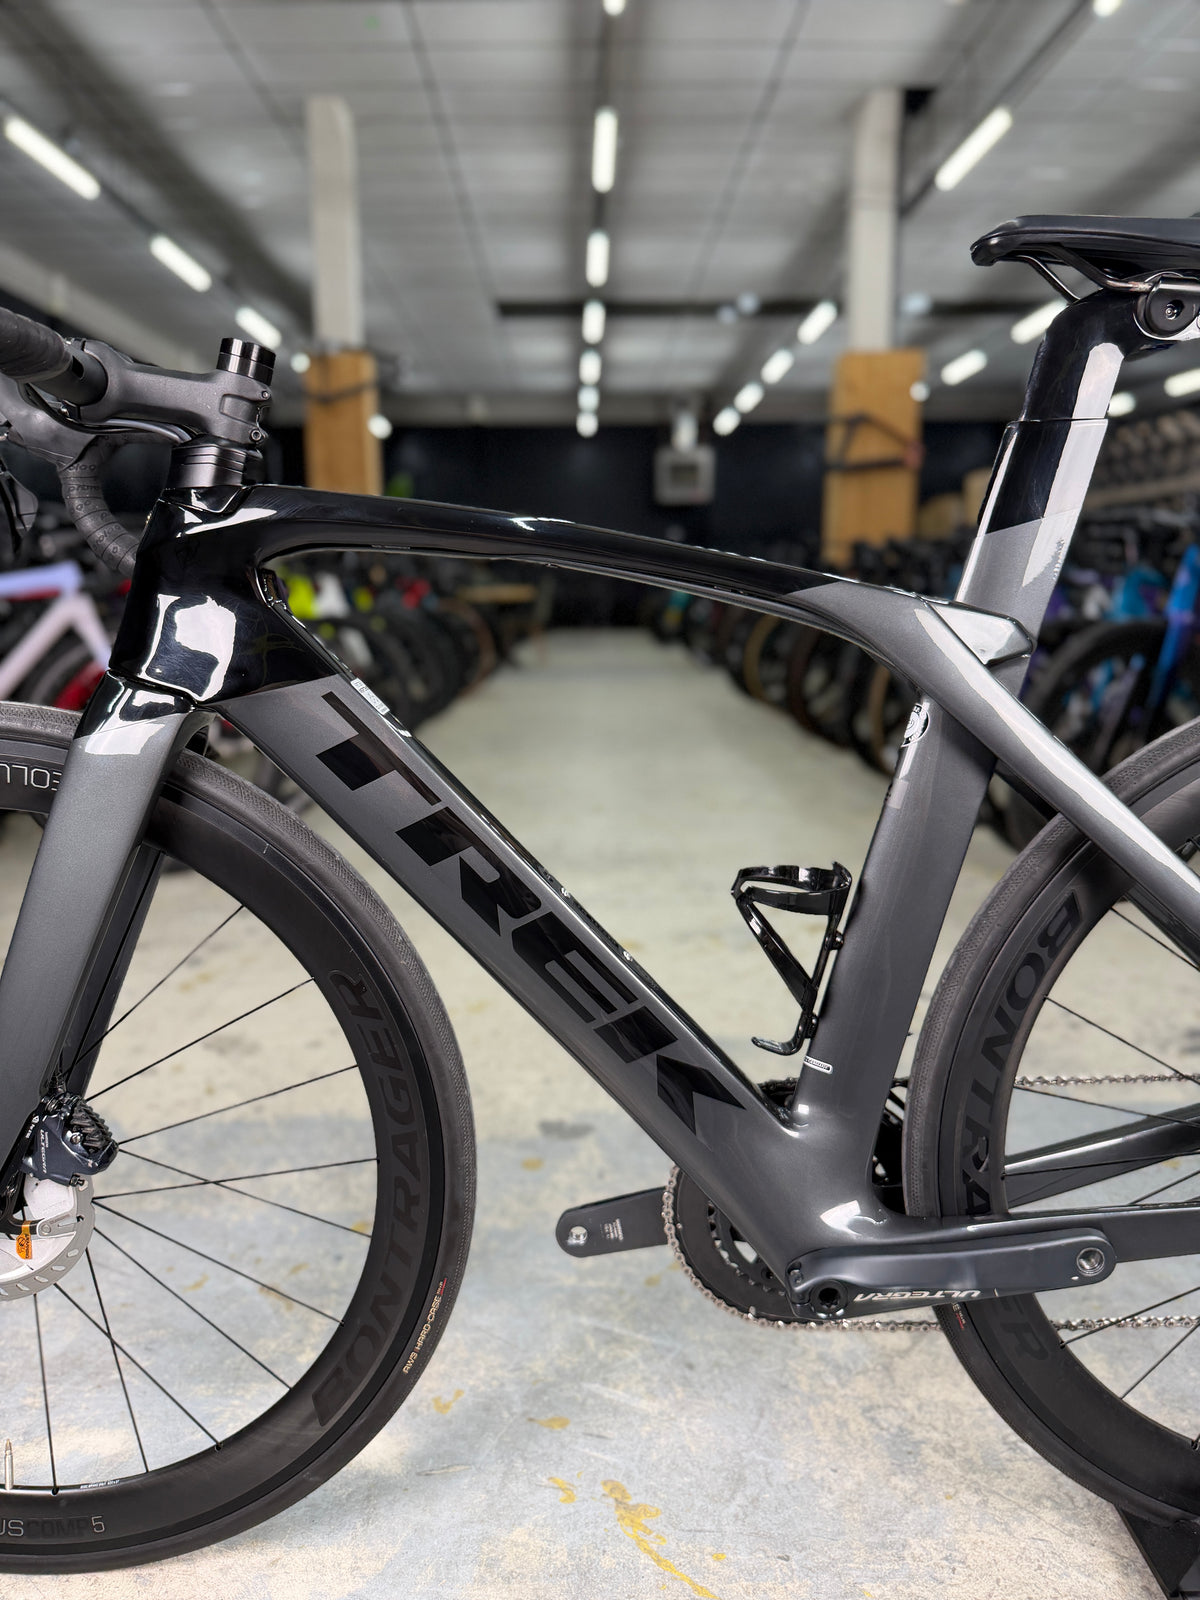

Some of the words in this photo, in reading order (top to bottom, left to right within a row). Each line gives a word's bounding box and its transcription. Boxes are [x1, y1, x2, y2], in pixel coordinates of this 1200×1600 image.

[315, 691, 747, 1136] TREK
[312, 969, 421, 1427] BONTRAGER
[415, 1295, 442, 1351] HARD-CASE
[853, 1289, 981, 1302] ULTEGRA
